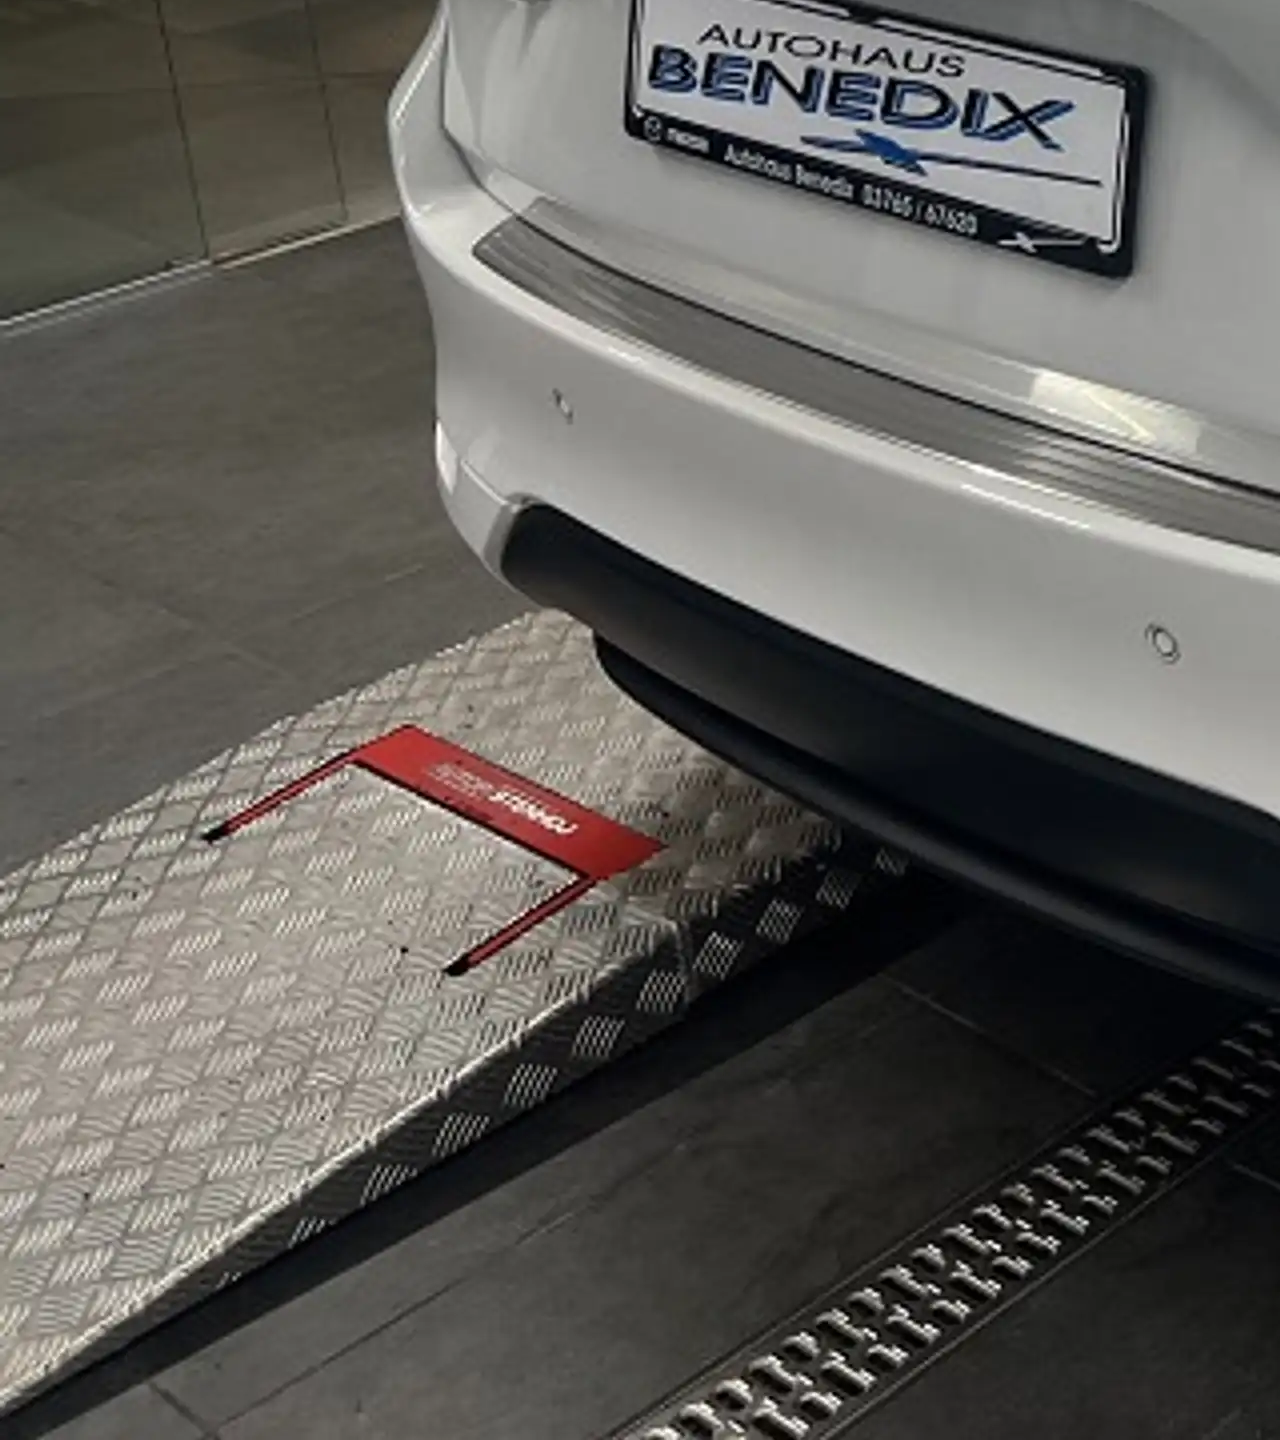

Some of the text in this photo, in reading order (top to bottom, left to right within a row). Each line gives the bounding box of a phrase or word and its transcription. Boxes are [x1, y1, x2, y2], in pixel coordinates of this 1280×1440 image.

[696, 23, 967, 78] AUTOHAUS
[648, 42, 1075, 152] BENEDIX
[723, 143, 793, 182] Autohaus
